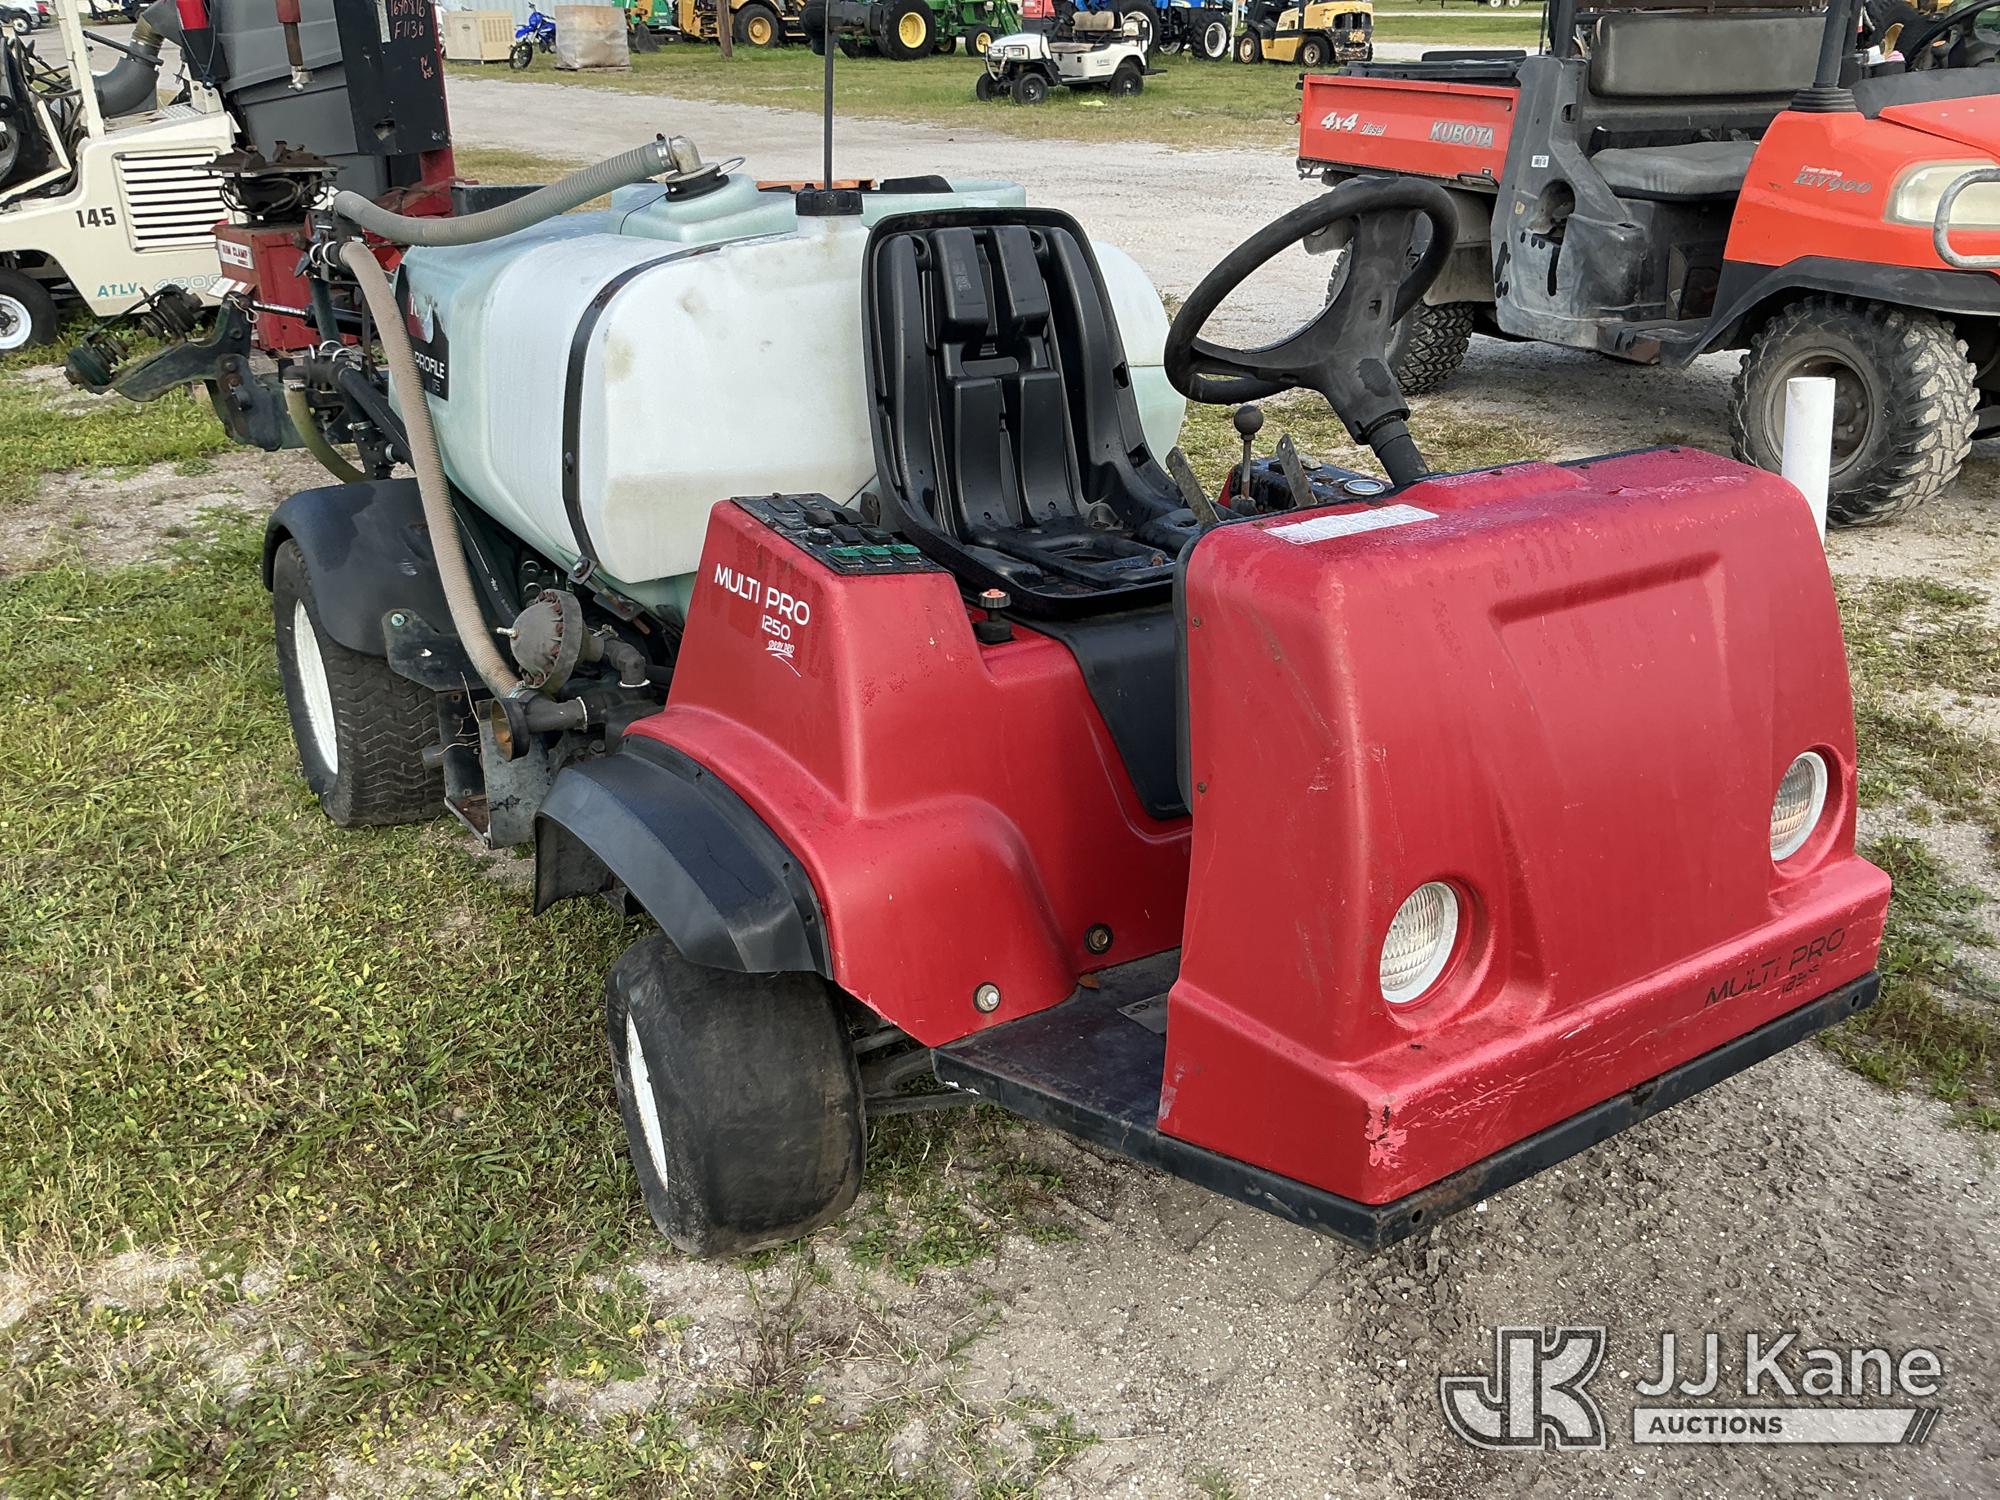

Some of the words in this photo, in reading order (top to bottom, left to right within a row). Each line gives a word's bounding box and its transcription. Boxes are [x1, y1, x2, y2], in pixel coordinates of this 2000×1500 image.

[1321, 112, 1358, 131] 4x4
[1428, 121, 1494, 147] KUBOTA
[76, 207, 116, 228] 145
[97, 282, 138, 298] ATLV
[714, 563, 760, 604] MULTI
[766, 586, 810, 626] PRO
[762, 614, 791, 640] 1250
[1704, 956, 1782, 1008] MULTI
[1789, 927, 1845, 971] PRO
